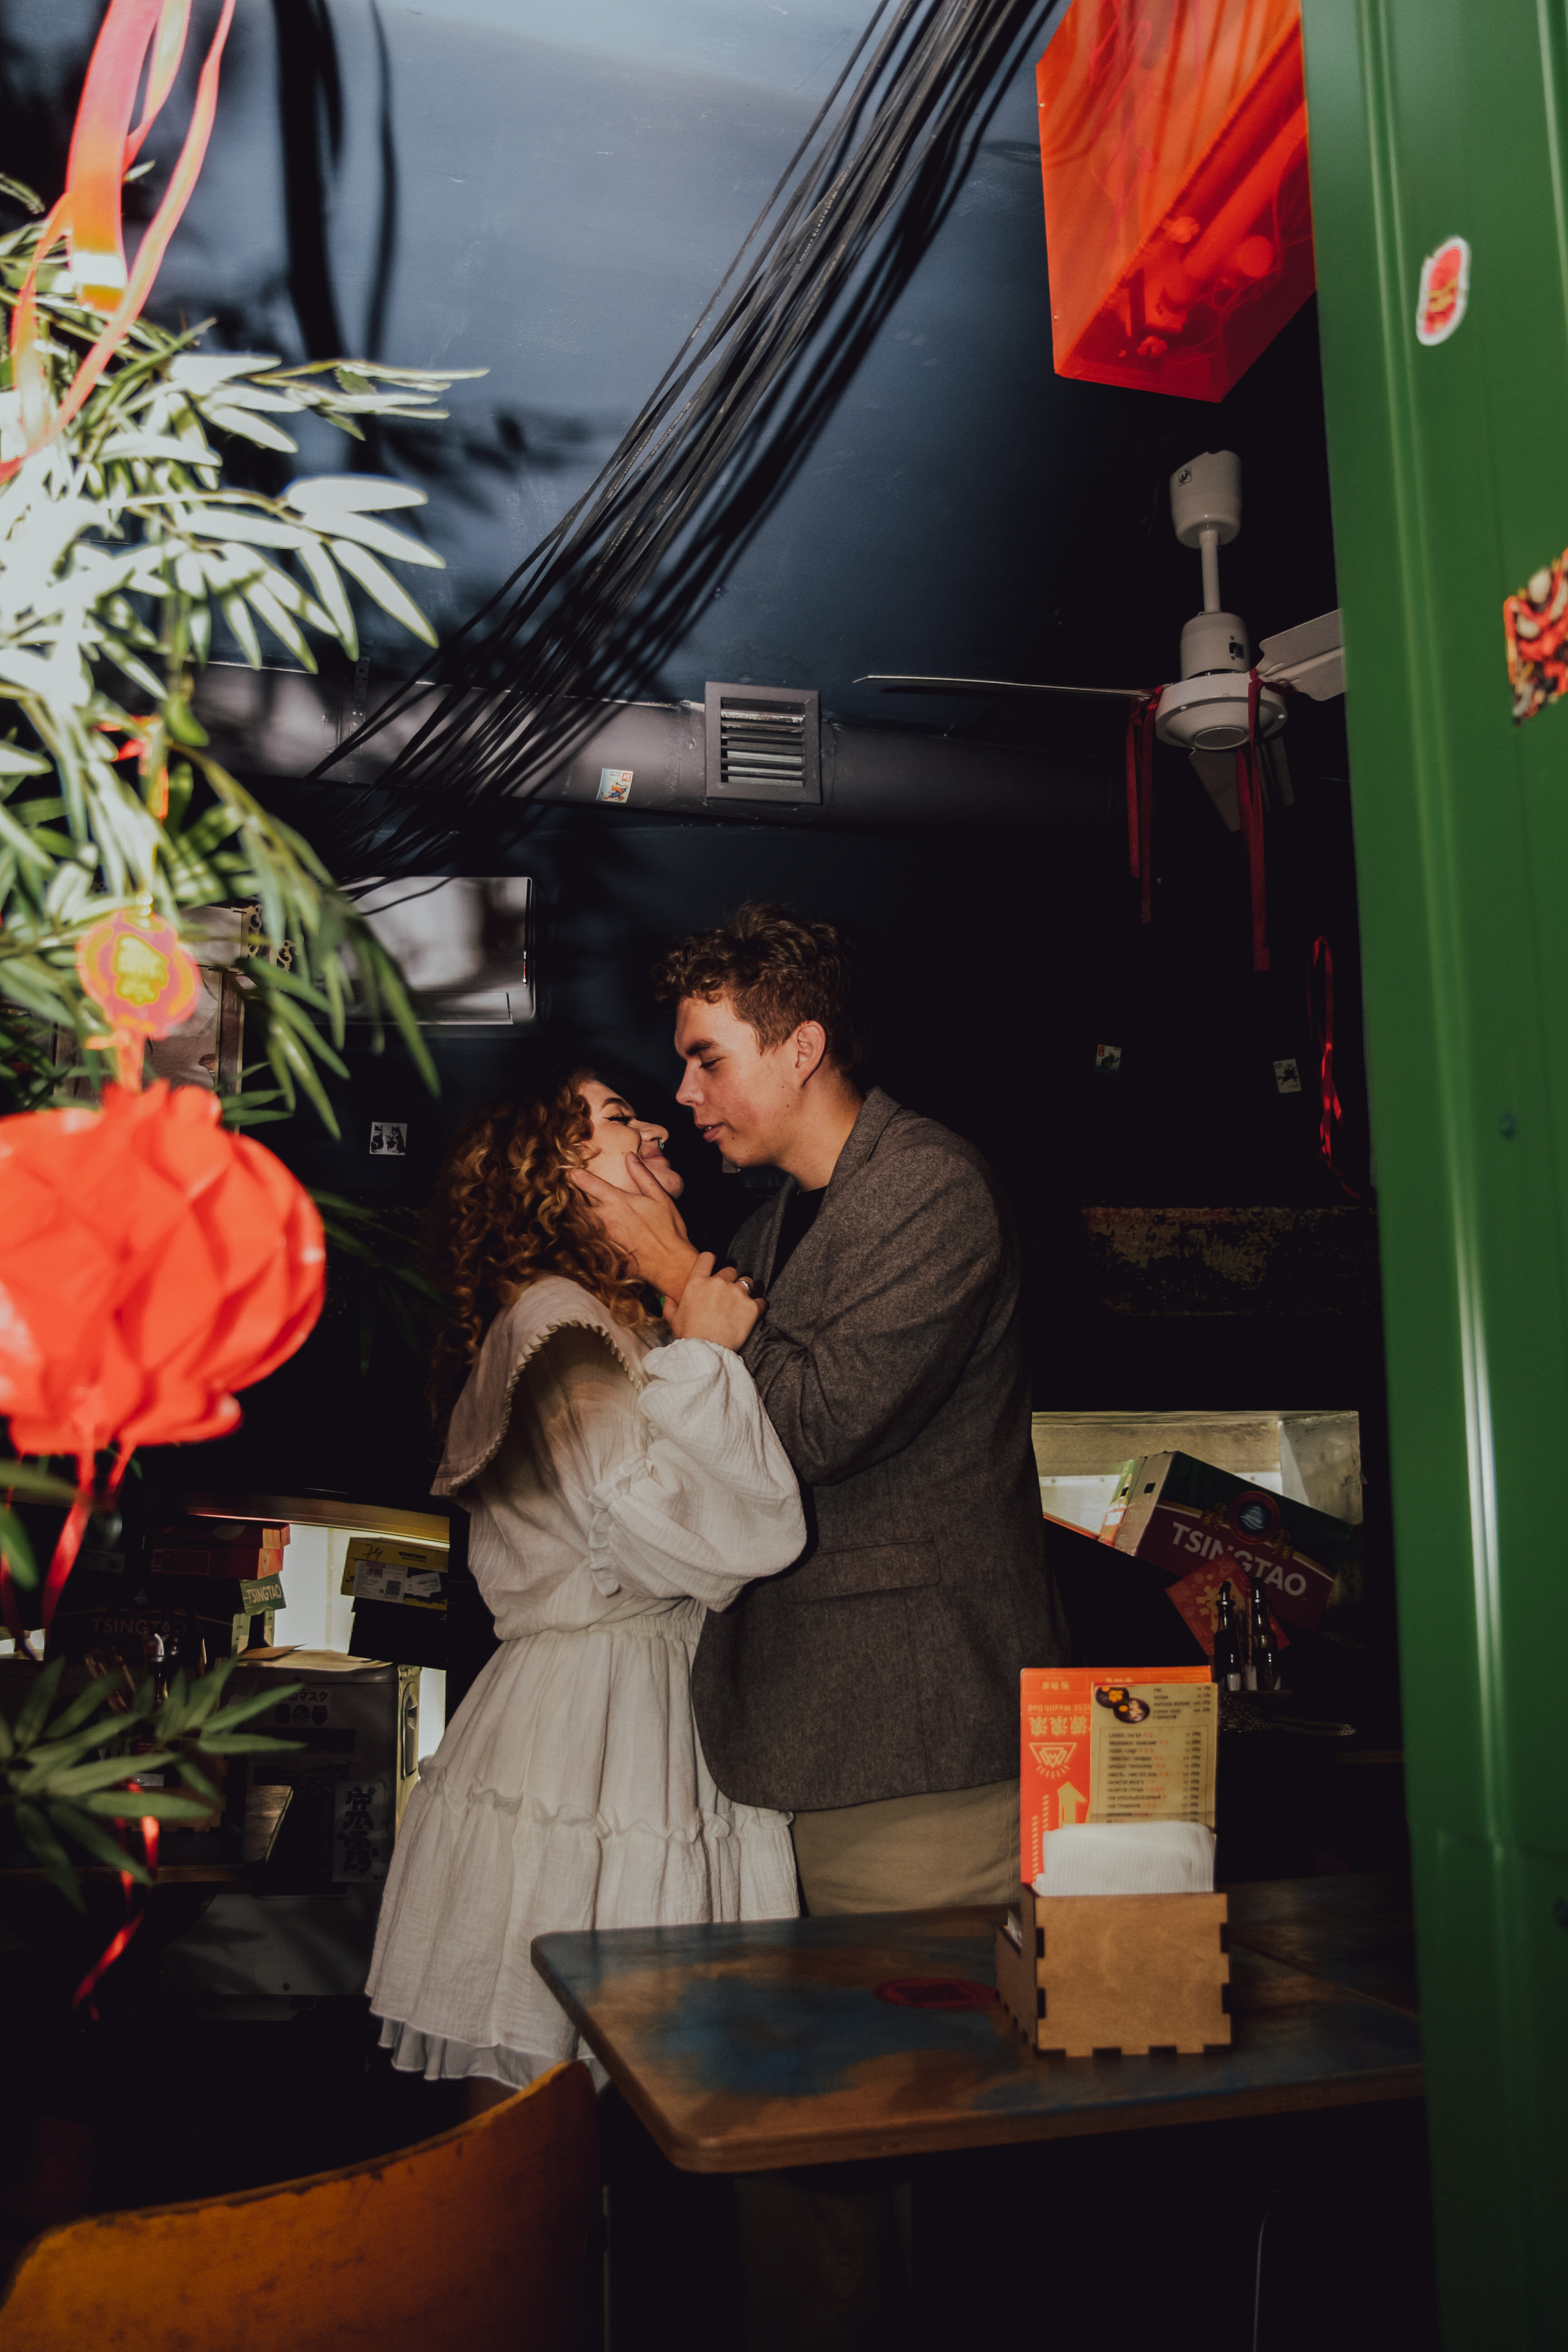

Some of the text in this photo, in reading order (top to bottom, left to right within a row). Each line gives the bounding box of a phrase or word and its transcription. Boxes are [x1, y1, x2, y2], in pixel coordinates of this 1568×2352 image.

[246, 1584, 282, 1604] TSINGTAO
[283, 1691, 328, 1702] のマスク
[1028, 1704, 1043, 1713] God
